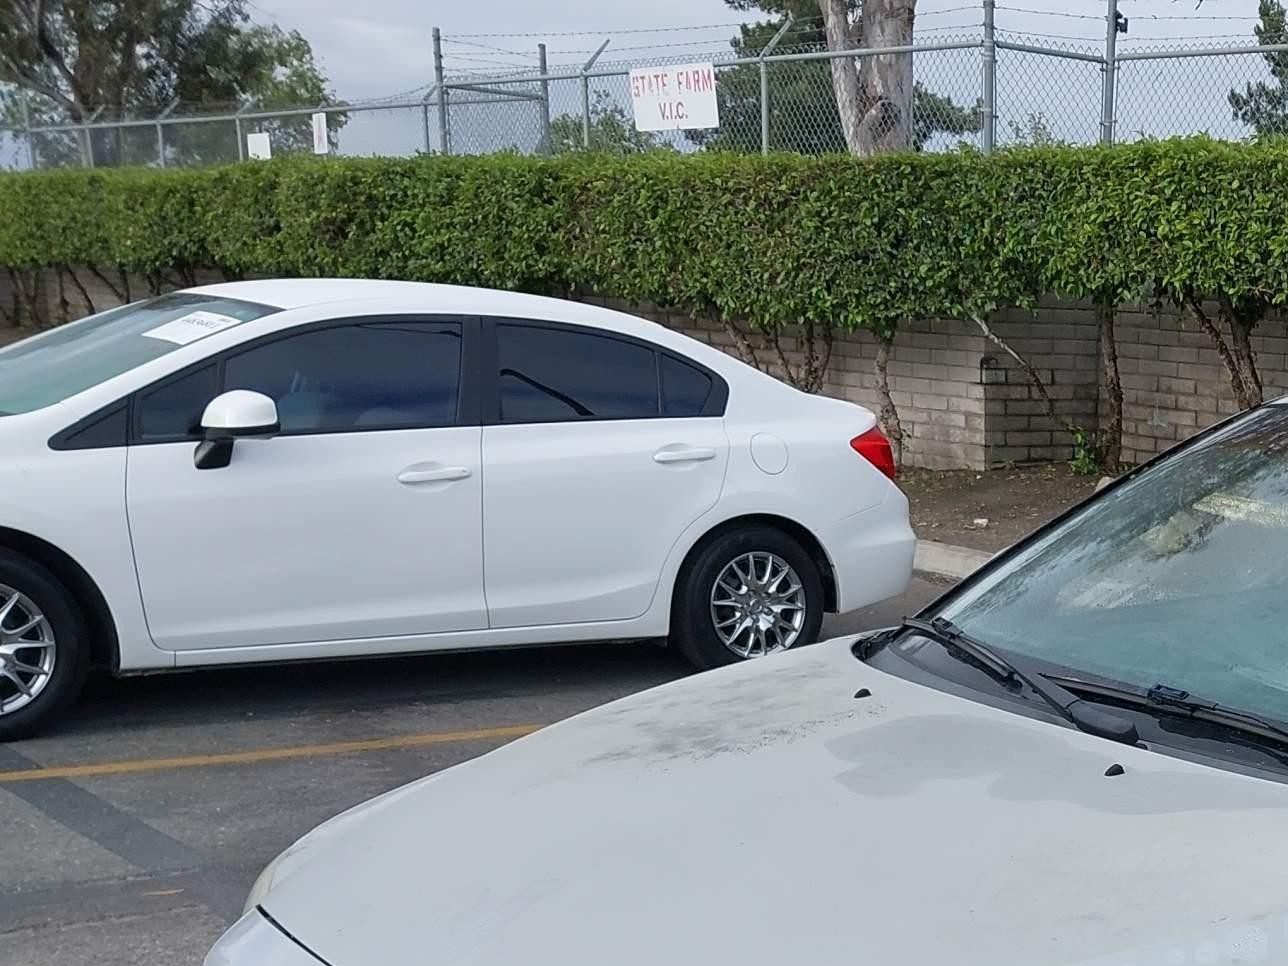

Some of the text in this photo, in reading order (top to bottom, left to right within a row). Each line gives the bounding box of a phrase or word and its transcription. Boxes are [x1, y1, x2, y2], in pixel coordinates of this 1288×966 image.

[632, 69, 713, 97] STATE FARM
[659, 101, 689, 120] V.I.C.
